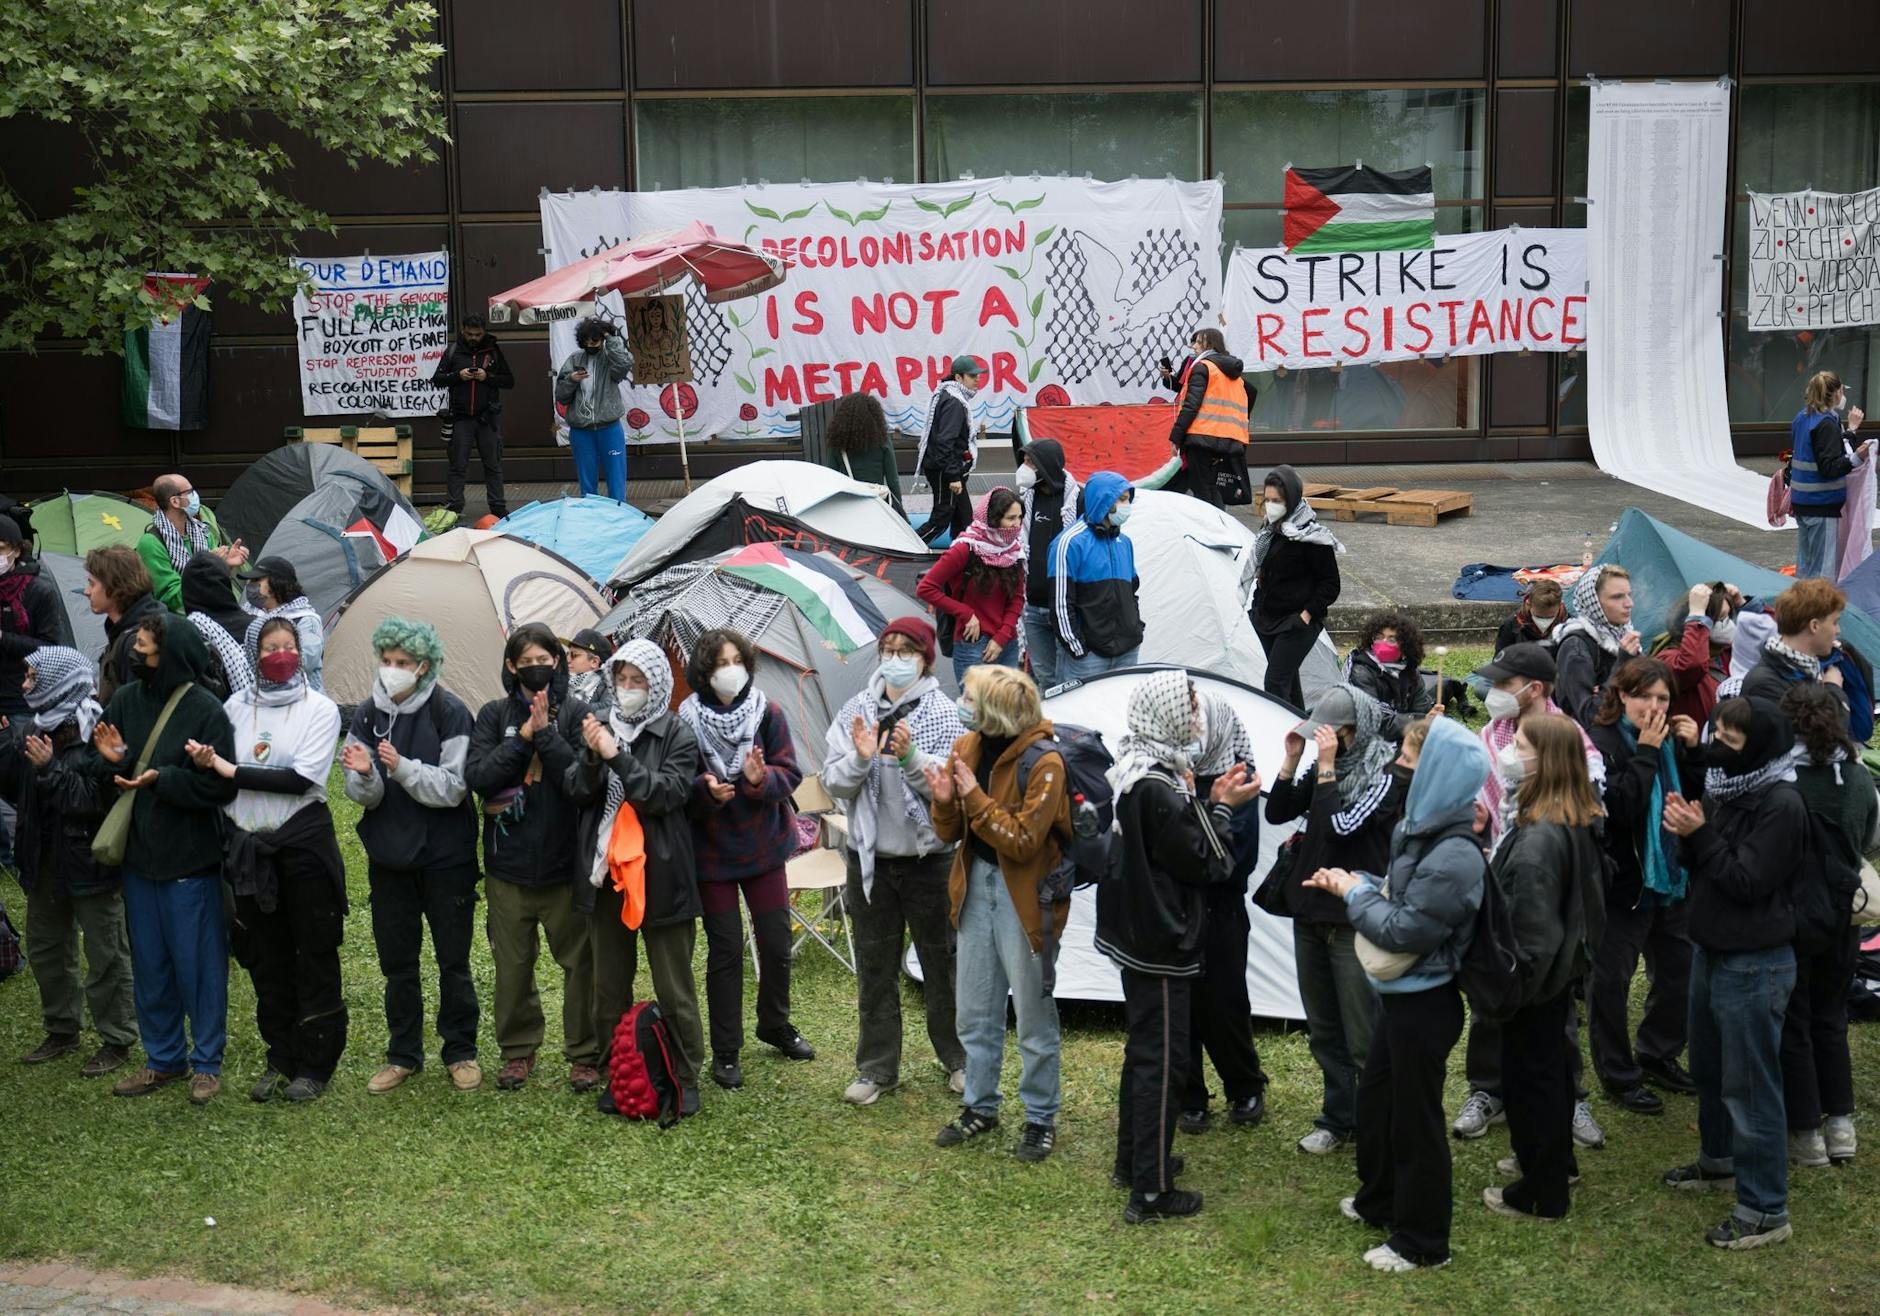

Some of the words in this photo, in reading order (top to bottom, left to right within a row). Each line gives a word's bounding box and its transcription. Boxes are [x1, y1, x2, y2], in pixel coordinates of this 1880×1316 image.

[1751, 196, 1806, 227] WENN
[1752, 228, 1776, 260] ZU
[1785, 227, 1844, 260] RECHT
[300, 262, 347, 283] OUR
[1252, 248, 1457, 304] STRIKE
[1501, 243, 1551, 291] IS
[1751, 261, 1797, 294] WIRD
[308, 293, 355, 313] STOP
[362, 293, 394, 308] THE
[534, 305, 577, 321] Marlboro
[766, 290, 824, 340] IS
[851, 289, 960, 335] NOT
[978, 285, 1019, 328] A
[1754, 294, 1795, 326] ZUR
[302, 316, 364, 341] FULL
[1256, 296, 1587, 361] RESISTANCE
[323, 338, 384, 355] BOYCOTT
[388, 337, 406, 351] OF
[305, 359, 338, 372] STOP
[346, 353, 416, 369] REPRESSION
[356, 366, 418, 379] STUDENTS
[309, 379, 398, 396] RECOGNISE
